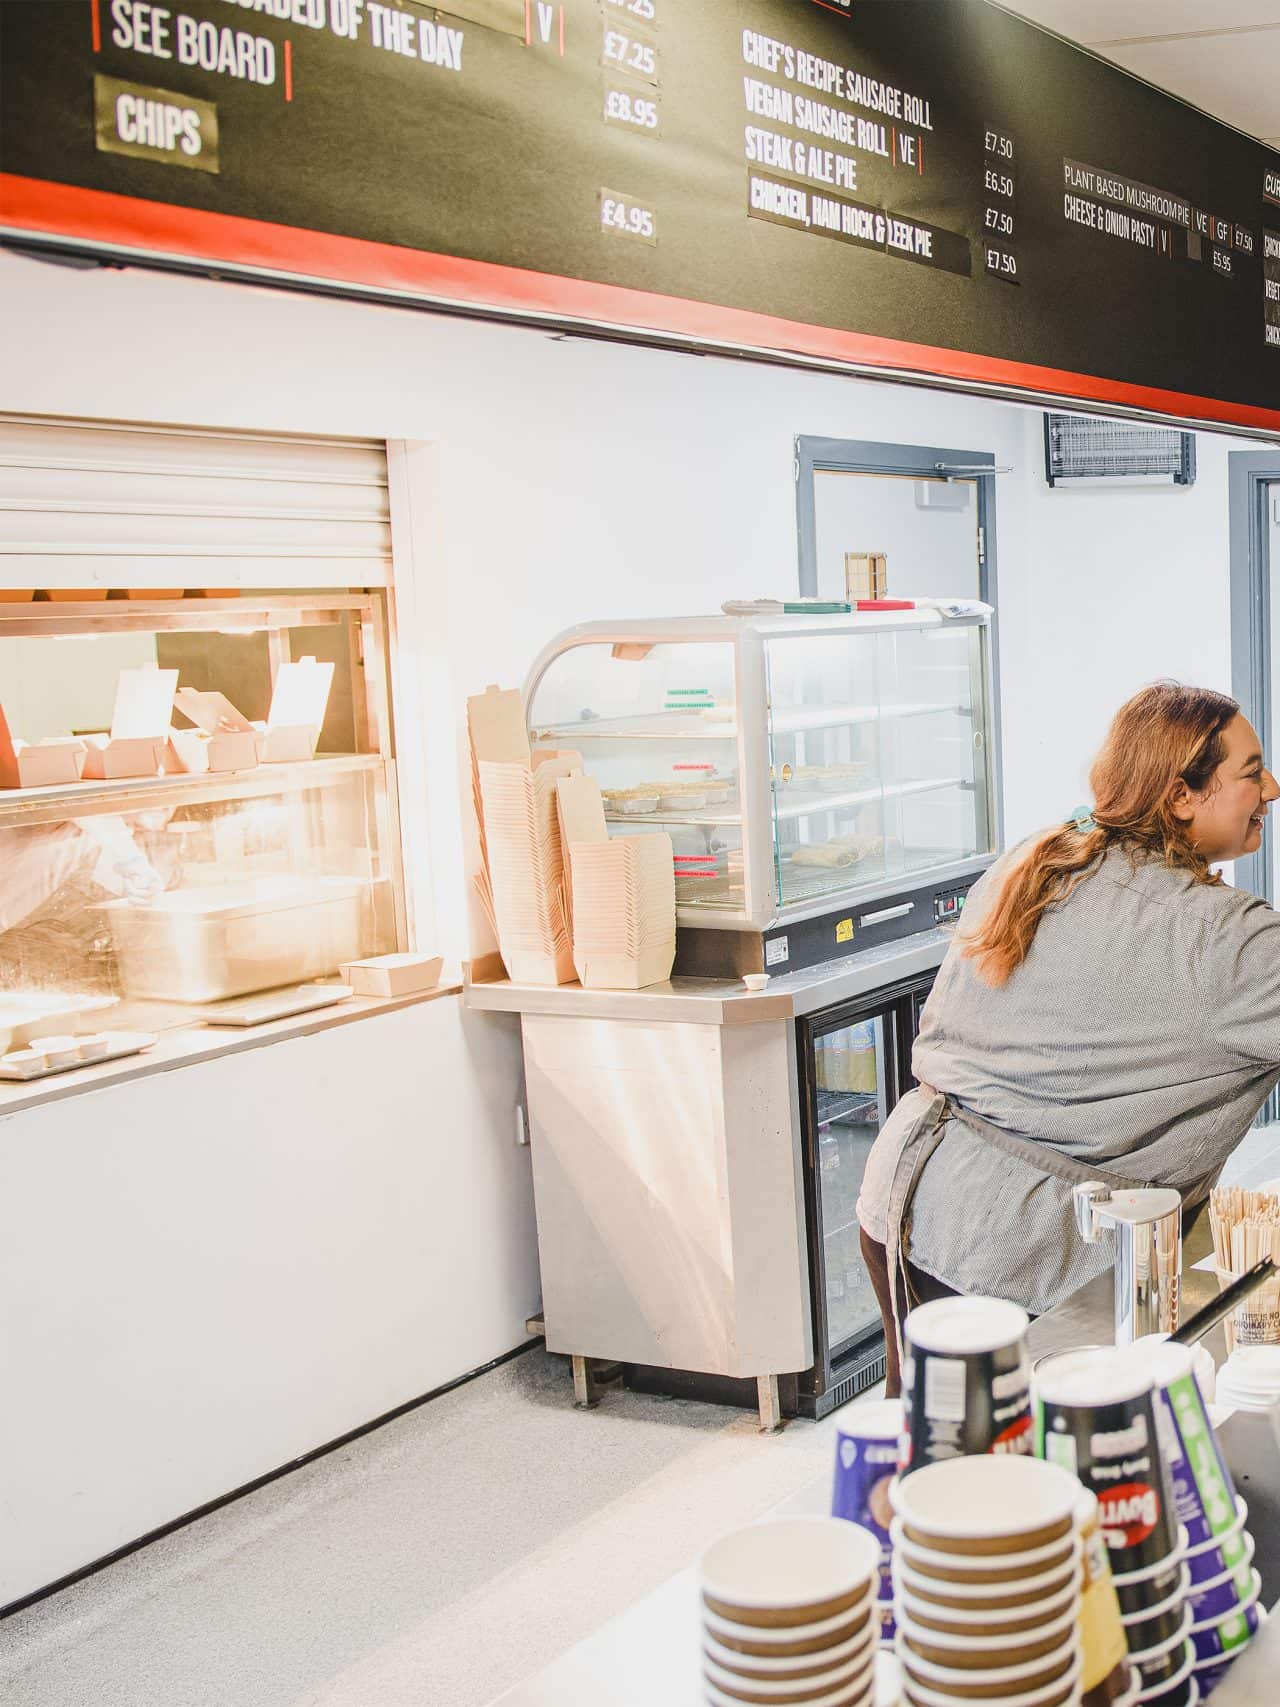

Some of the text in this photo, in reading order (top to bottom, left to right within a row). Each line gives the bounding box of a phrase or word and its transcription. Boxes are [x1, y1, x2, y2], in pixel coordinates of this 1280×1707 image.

[111, 0, 275, 85] SEE BOARD
[330, 0, 363, 40] OF
[366, 2, 417, 57] THE
[418, 18, 464, 71] DAY
[537, 1, 553, 42] V
[604, 31, 655, 74] £7.25
[742, 29, 934, 130] CHEF'S RECIPE SAUSAGE ROLL
[116, 94, 201, 156] CHIPS
[607, 91, 657, 128] £8.95
[743, 76, 915, 166] VEGAN SAUSAGE ROLL VE
[745, 126, 857, 191] STEAK & ALE PIE
[984, 131, 1013, 159] £7.50
[985, 170, 1013, 197] £6.50
[1064, 165, 1228, 241] PLANT BASED MUSHROOM PIE VE GF
[602, 199, 654, 236] £4.95
[812, 195, 840, 231] HAM
[842, 205, 874, 240] HOCK
[875, 215, 885, 243] &
[887, 218, 914, 253] LEEK
[915, 228, 932, 258] PIE
[985, 208, 1013, 235] £7.50
[1064, 194, 1167, 252] CHEESE & ONION PASTY V
[988, 250, 1017, 274] £7.50
[1213, 251, 1231, 271] £5.95
